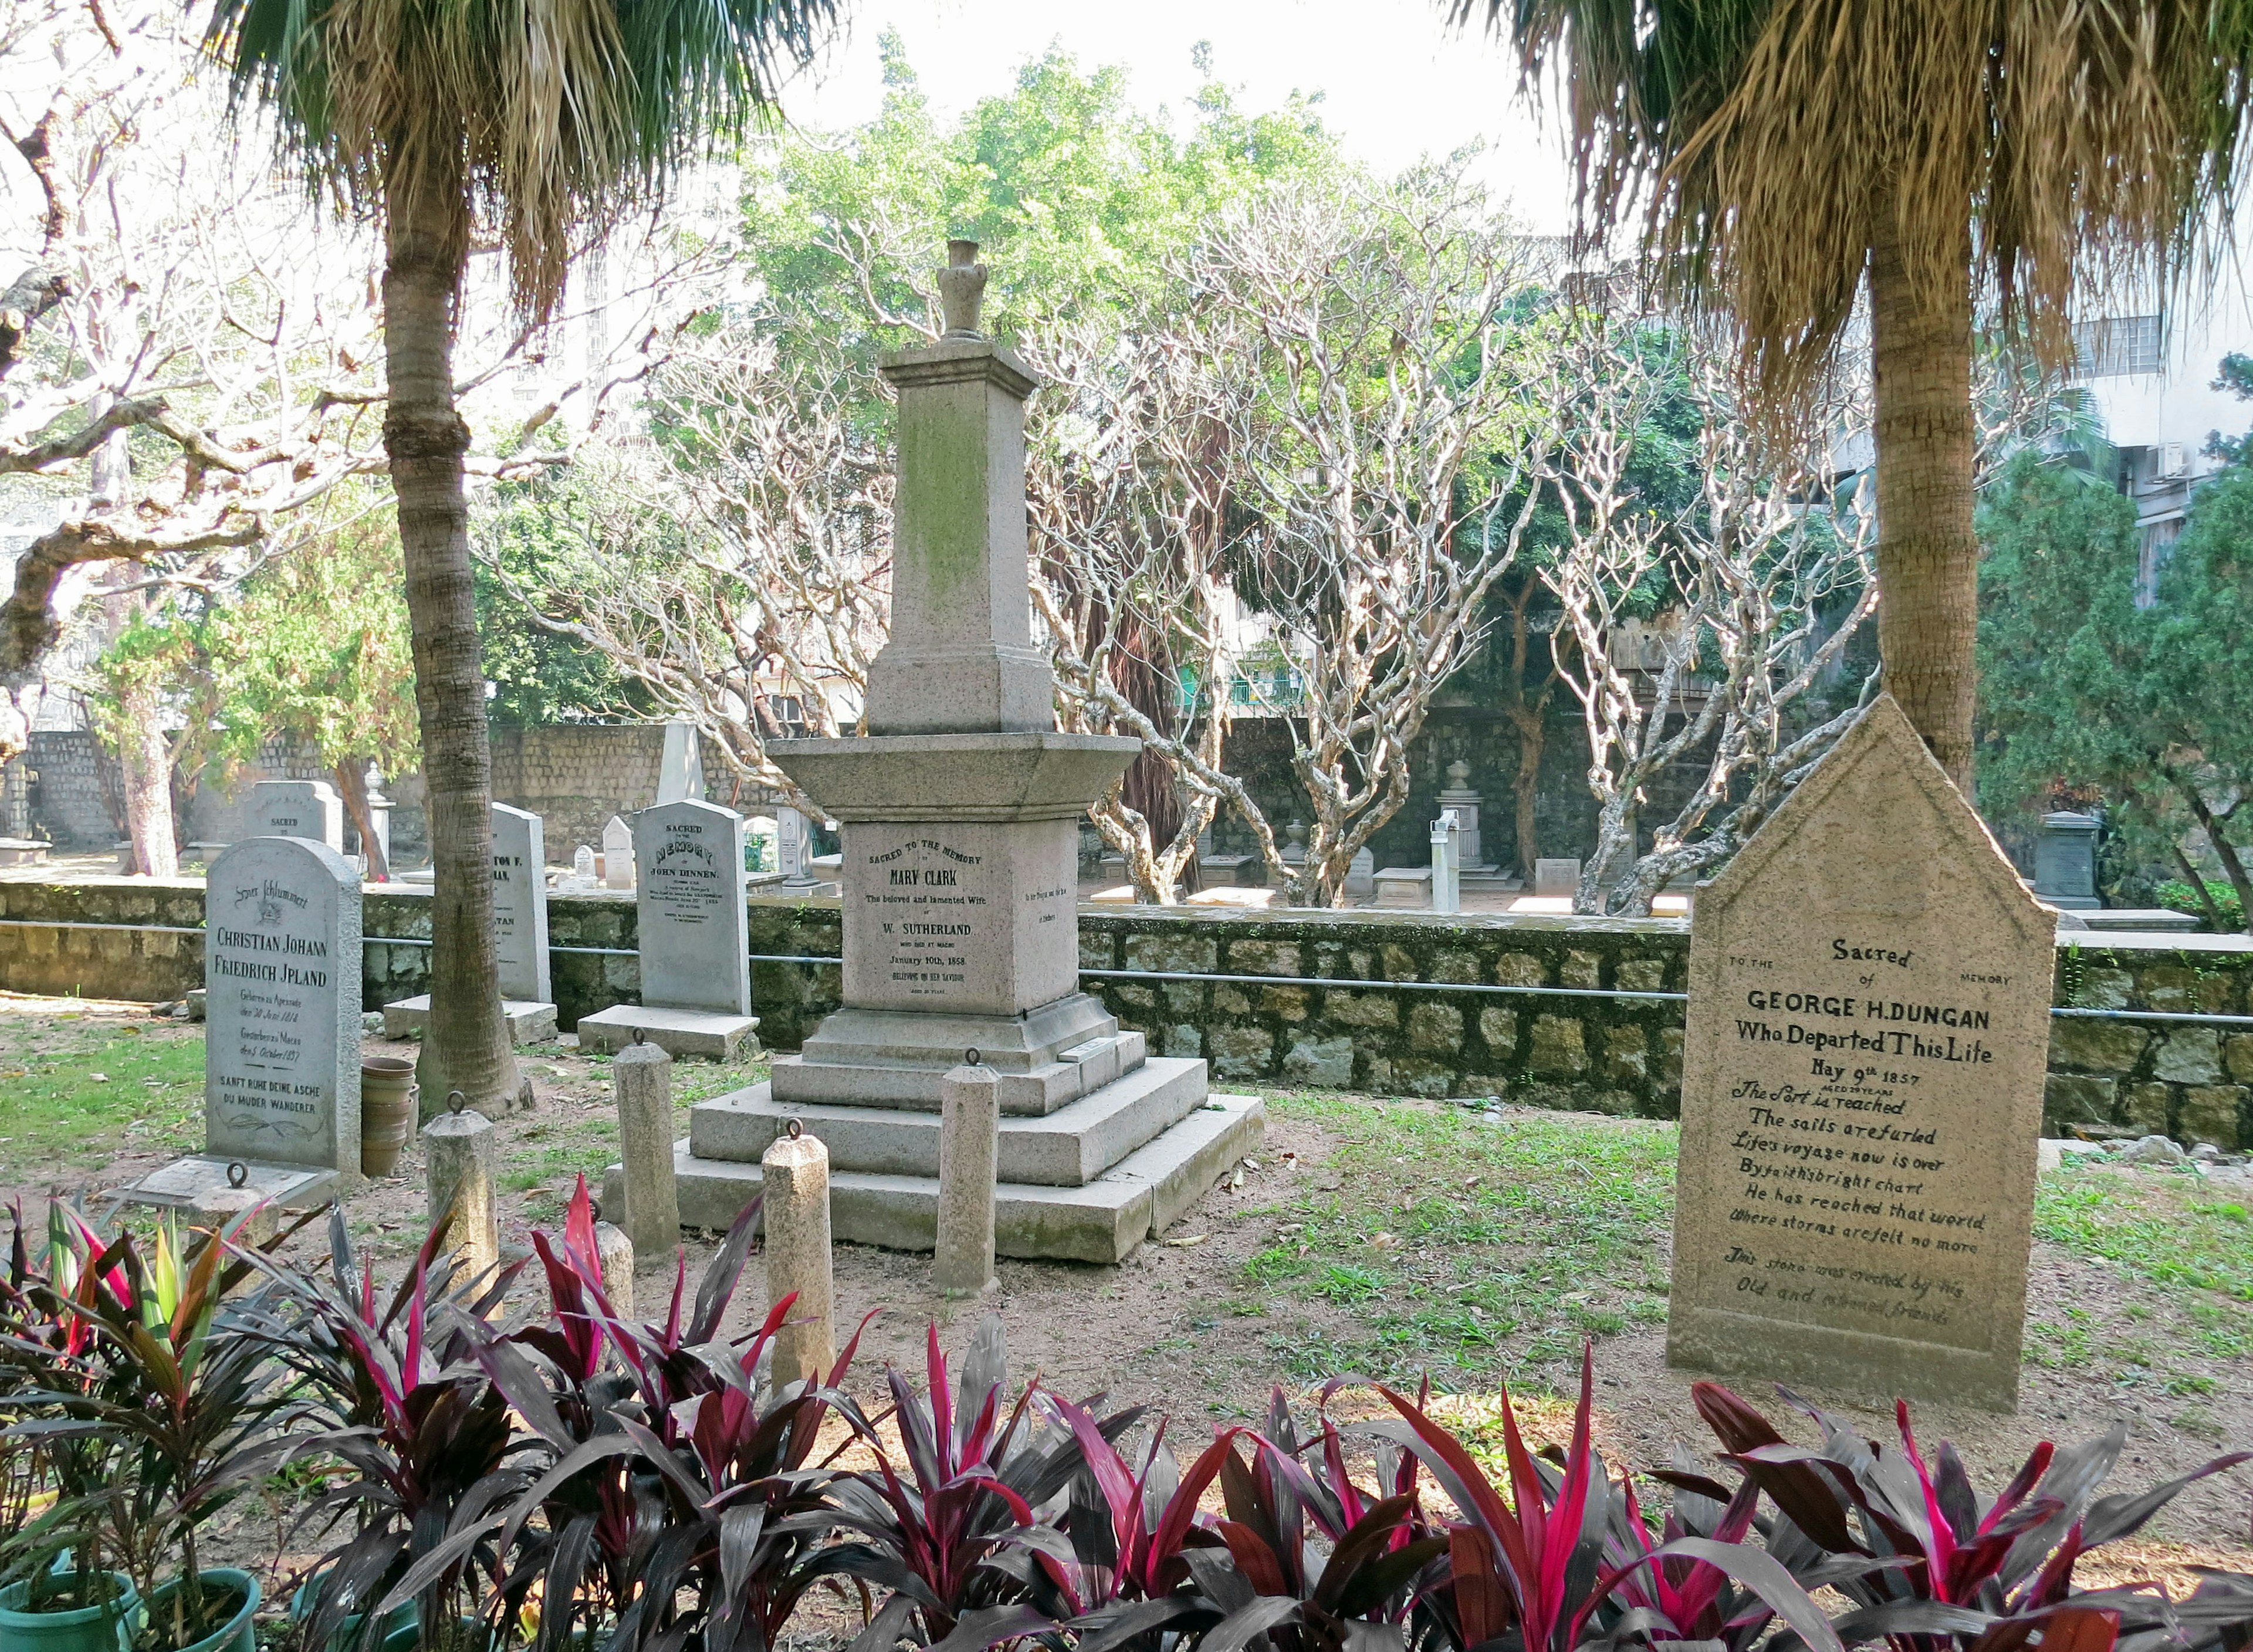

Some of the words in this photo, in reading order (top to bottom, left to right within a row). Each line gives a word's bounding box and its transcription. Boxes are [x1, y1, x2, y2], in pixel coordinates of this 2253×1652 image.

[271, 818, 298, 827] SACRED
[666, 825, 702, 834] SACRED
[656, 841, 712, 866] MEMORY
[869, 849, 902, 864] SACRED
[905, 841, 917, 851] TO
[921, 839, 939, 850] THE
[942, 846, 982, 865] MEMORY
[925, 869, 957, 886] CLARK
[865, 895, 880, 903] The
[883, 895, 910, 903] beloved
[913, 895, 927, 903] and
[930, 896, 965, 905] lamented
[968, 896, 986, 905] Wife
[218, 927, 280, 952] CHRISTIAN
[283, 934, 327, 957] JOHANN
[883, 923, 895, 934] W.
[903, 923, 972, 935] SUTHERLAND
[889, 956, 922, 966] January
[925, 956, 945, 966] 10th,
[1832, 939, 1914, 968] Sacred
[215, 954, 276, 981] FRIEDRICH
[1960, 973, 2011, 986] MEMORY
[1859, 973, 1875, 989] of
[1747, 990, 1856, 1017] GEORGE
[280, 1031, 301, 1045] Macao
[1735, 1020, 1782, 1042] Who
[1787, 1024, 1885, 1054] Departed
[1887, 1031, 1943, 1059] This
[1945, 1035, 1993, 1064] Life
[1811, 1058, 1846, 1083] May
[1853, 1066, 1877, 1086] 9th
[1882, 1071, 1922, 1086] 1857
[221, 1076, 245, 1088] SANFT
[248, 1078, 266, 1091] RUHE
[269, 1081, 291, 1094] DEINE
[294, 1085, 320, 1097] ASCHE
[1731, 1081, 1767, 1100] The
[1812, 1092, 1829, 1108] is
[1836, 1097, 1907, 1115] reached
[1821, 1085, 1848, 1094] AGED
[1860, 1087, 1895, 1097] YEARS
[224, 1094, 235, 1103] DU
[270, 1099, 316, 1114] WANDERER
[1750, 1107, 1785, 1127] The
[1790, 1116, 1836, 1134] sails
[1782, 1143, 1844, 1161] voyage
[1850, 1150, 1885, 1164] now
[1892, 1152, 1909, 1170] is
[1913, 1159, 1946, 1172] over
[1739, 1157, 1763, 1178] By
[1875, 1177, 1924, 1195] chart
[1744, 1183, 1768, 1201] He
[1775, 1189, 1803, 1205] has
[1810, 1196, 1883, 1216] reached
[1889, 1203, 1925, 1223] that
[1930, 1214, 1986, 1231] world
[1729, 1208, 1777, 1226] Where
[1782, 1216, 1836, 1235] storms
[1910, 1236, 1930, 1249] no
[1936, 1239, 1979, 1254] more
[1724, 1246, 1757, 1266] This
[1765, 1257, 1805, 1274] stone
[1816, 1264, 1846, 1279] was
[1911, 1275, 1931, 1301] by
[1737, 1276, 1769, 1297] Old
[1777, 1285, 1814, 1303] and
